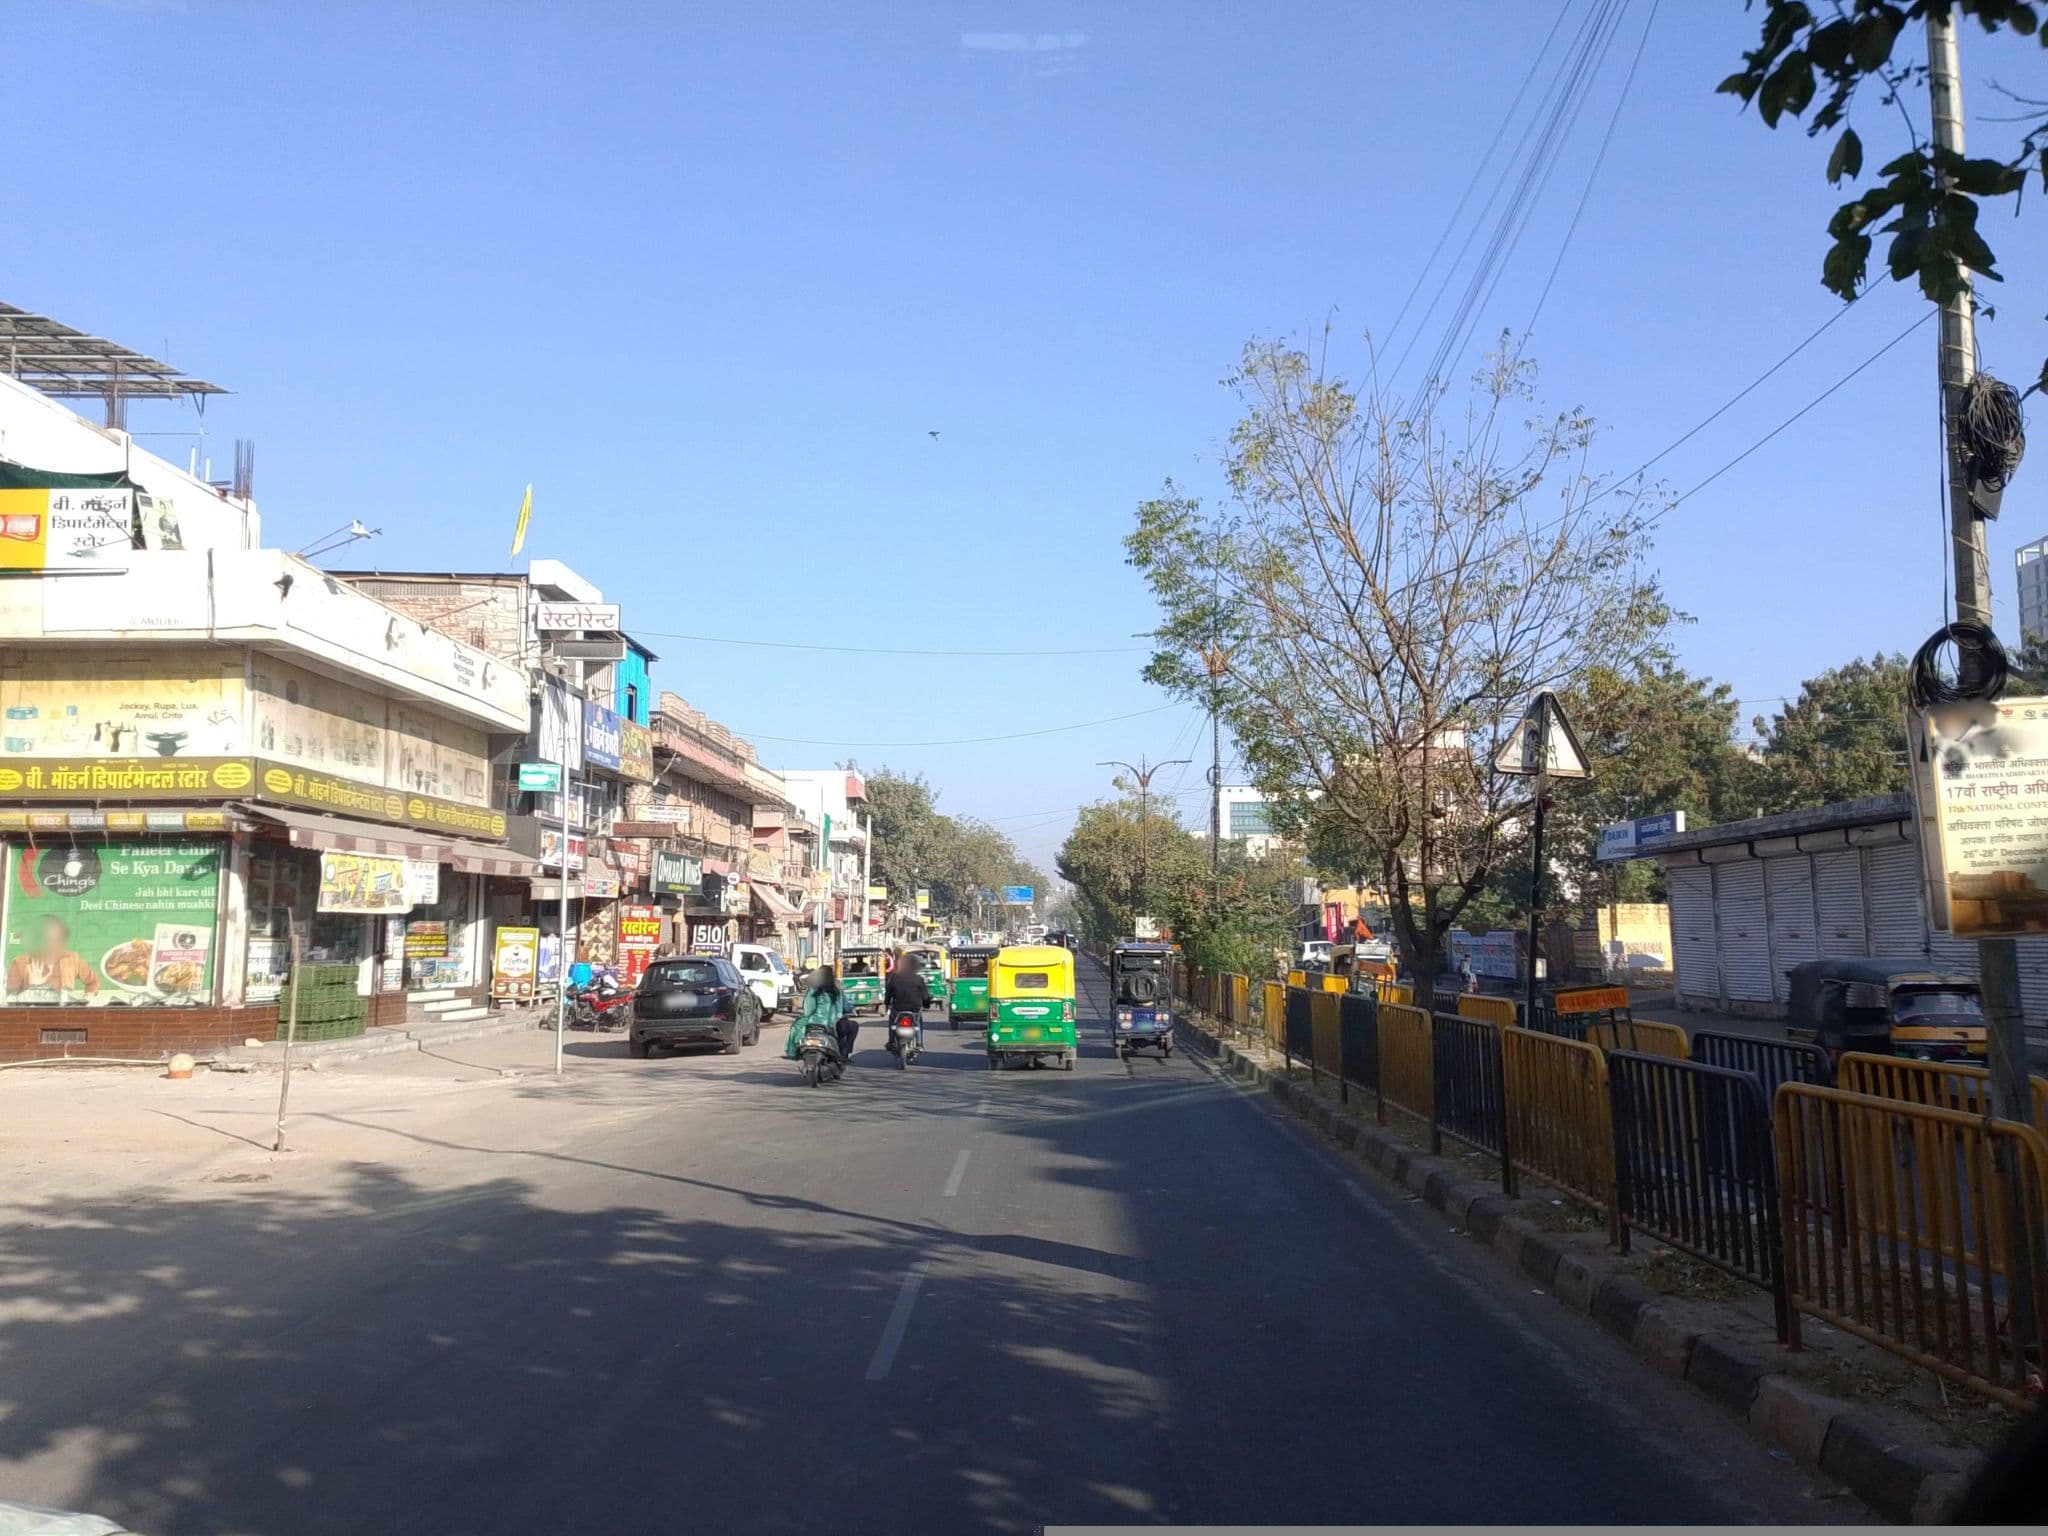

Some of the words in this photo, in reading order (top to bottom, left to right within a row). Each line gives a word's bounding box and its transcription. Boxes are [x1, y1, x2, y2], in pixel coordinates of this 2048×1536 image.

[73, 533, 107, 548] स्टोर
[542, 606, 616, 628] रेस्टोरेन्ट
[1974, 759, 2005, 770] भारतीय
[26, 766, 47, 790] बी.
[51, 765, 90, 790] मॉडर्न
[92, 765, 176, 790] डिपार्टमेन्टल
[177, 764, 208, 789] स्टोर
[1980, 781, 2018, 800] राष्ट्रीय
[1967, 803, 2015, 812] NATIONAL
[1947, 819, 1991, 832] अधिवक्ता
[111, 862, 129, 875] Se
[132, 861, 159, 877] Kya
[658, 855, 684, 884] OMKARA
[43, 874, 97, 889] Ching's
[135, 887, 155, 898] Jab
[157, 887, 173, 898] bhi
[175, 887, 199, 898] kare
[201, 887, 216, 898] dil
[81, 900, 102, 911] Desi
[104, 900, 145, 911] Chinese
[145, 900, 174, 910] nahin
[621, 917, 660, 935] रेस्टोरेन्ट
